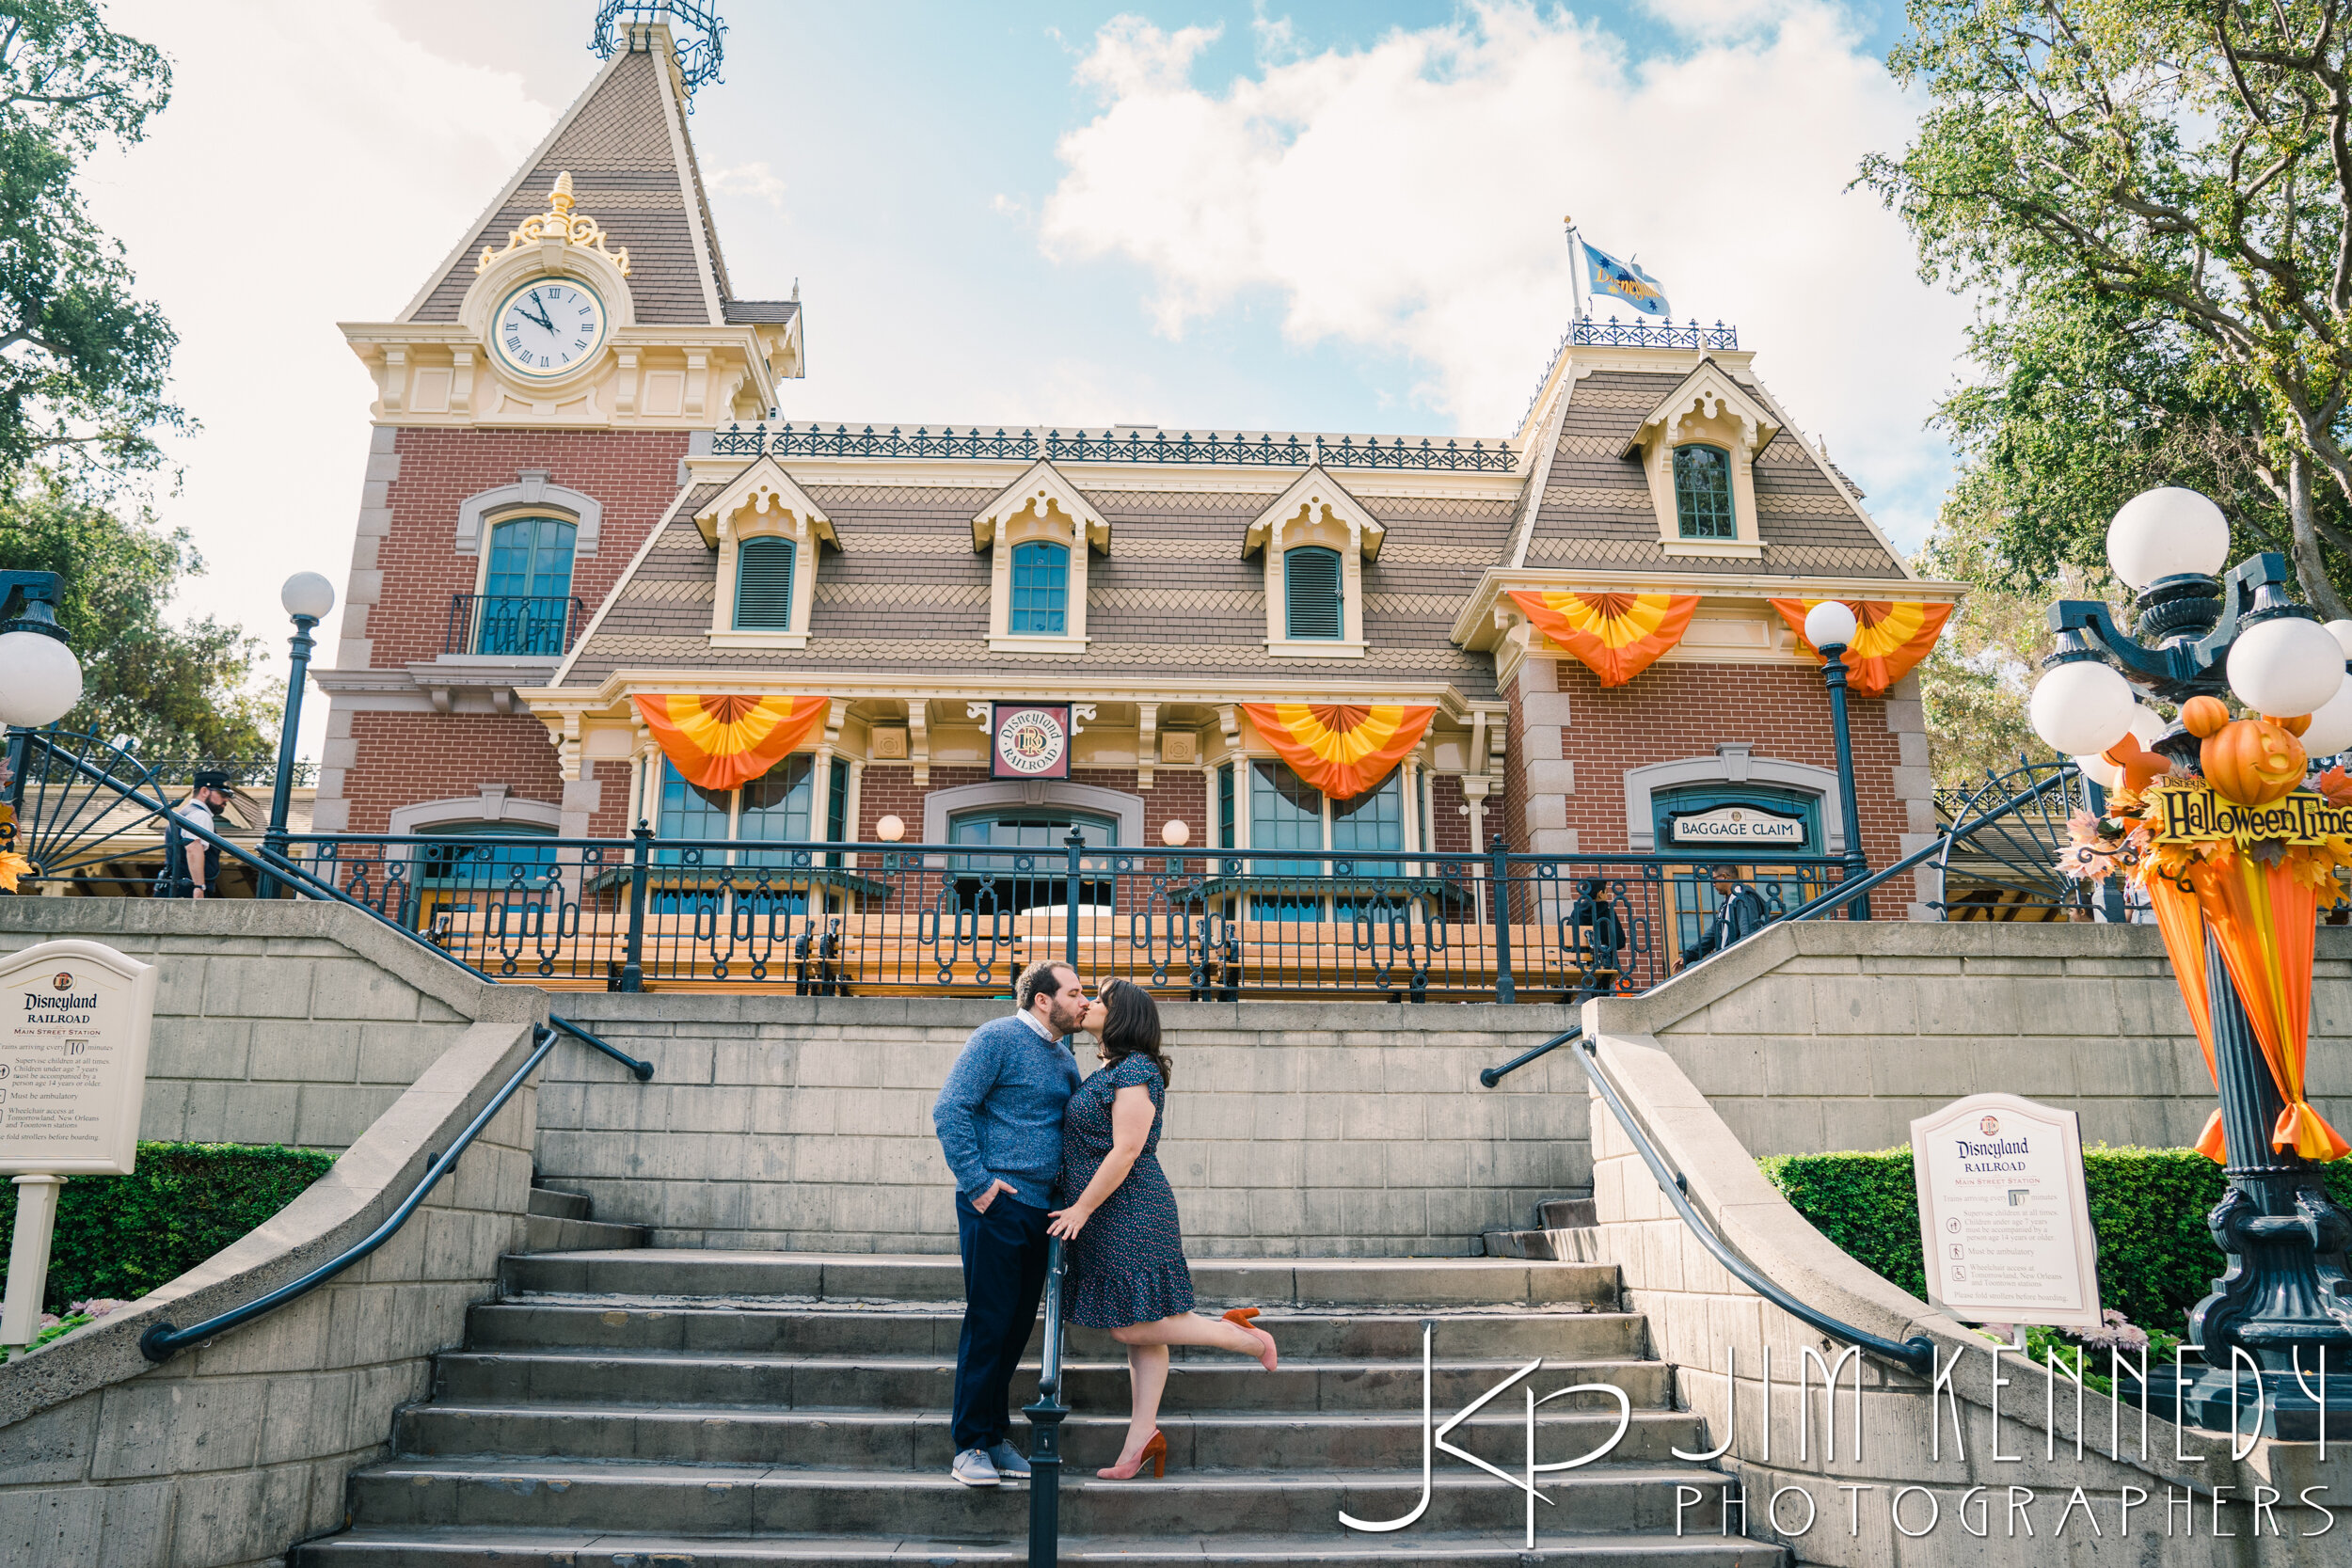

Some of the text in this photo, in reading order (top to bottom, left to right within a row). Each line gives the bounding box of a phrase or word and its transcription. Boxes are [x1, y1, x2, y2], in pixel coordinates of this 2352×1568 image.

[548, 288, 561, 299] XII
[1000, 713, 1062, 739] Disneyland
[1003, 748, 1058, 770] RAILROAD
[2162, 775, 2207, 791] Disney's
[1681, 822, 1794, 836] BAGGAGE CLAIM
[23, 992, 98, 1012] Disneyland
[27, 1015, 90, 1023] RAILROAD
[19, 1043, 45, 1052] arriving
[70, 1041, 86, 1055] 10
[83, 1072, 91, 1081] by
[40, 1092, 79, 1101] ambulatory
[1955, 1136, 2029, 1160] Disneyland
[1964, 1161, 2026, 1173] RAILROAD
[1943, 1195, 1963, 1203] Trains
[1963, 1195, 1990, 1204] arriving
[2013, 1193, 2026, 1206] 10
[1963, 1210, 1994, 1218] Supervise
[1994, 1209, 2022, 1217] children
[2030, 1219, 2048, 1227] years
[2033, 1226, 2042, 1234] by
[1966, 1234, 1988, 1243] person
[1996, 1247, 2035, 1257] ambulatory
[1970, 1263, 2006, 1272] Wheelchair
[2020, 1272, 2034, 1280] New
[2036, 1272, 2063, 1280] Orleans
[1984, 1278, 2017, 1287] Toontown
[1953, 1291, 1974, 1299] Please
[2015, 1292, 2037, 1301] before
